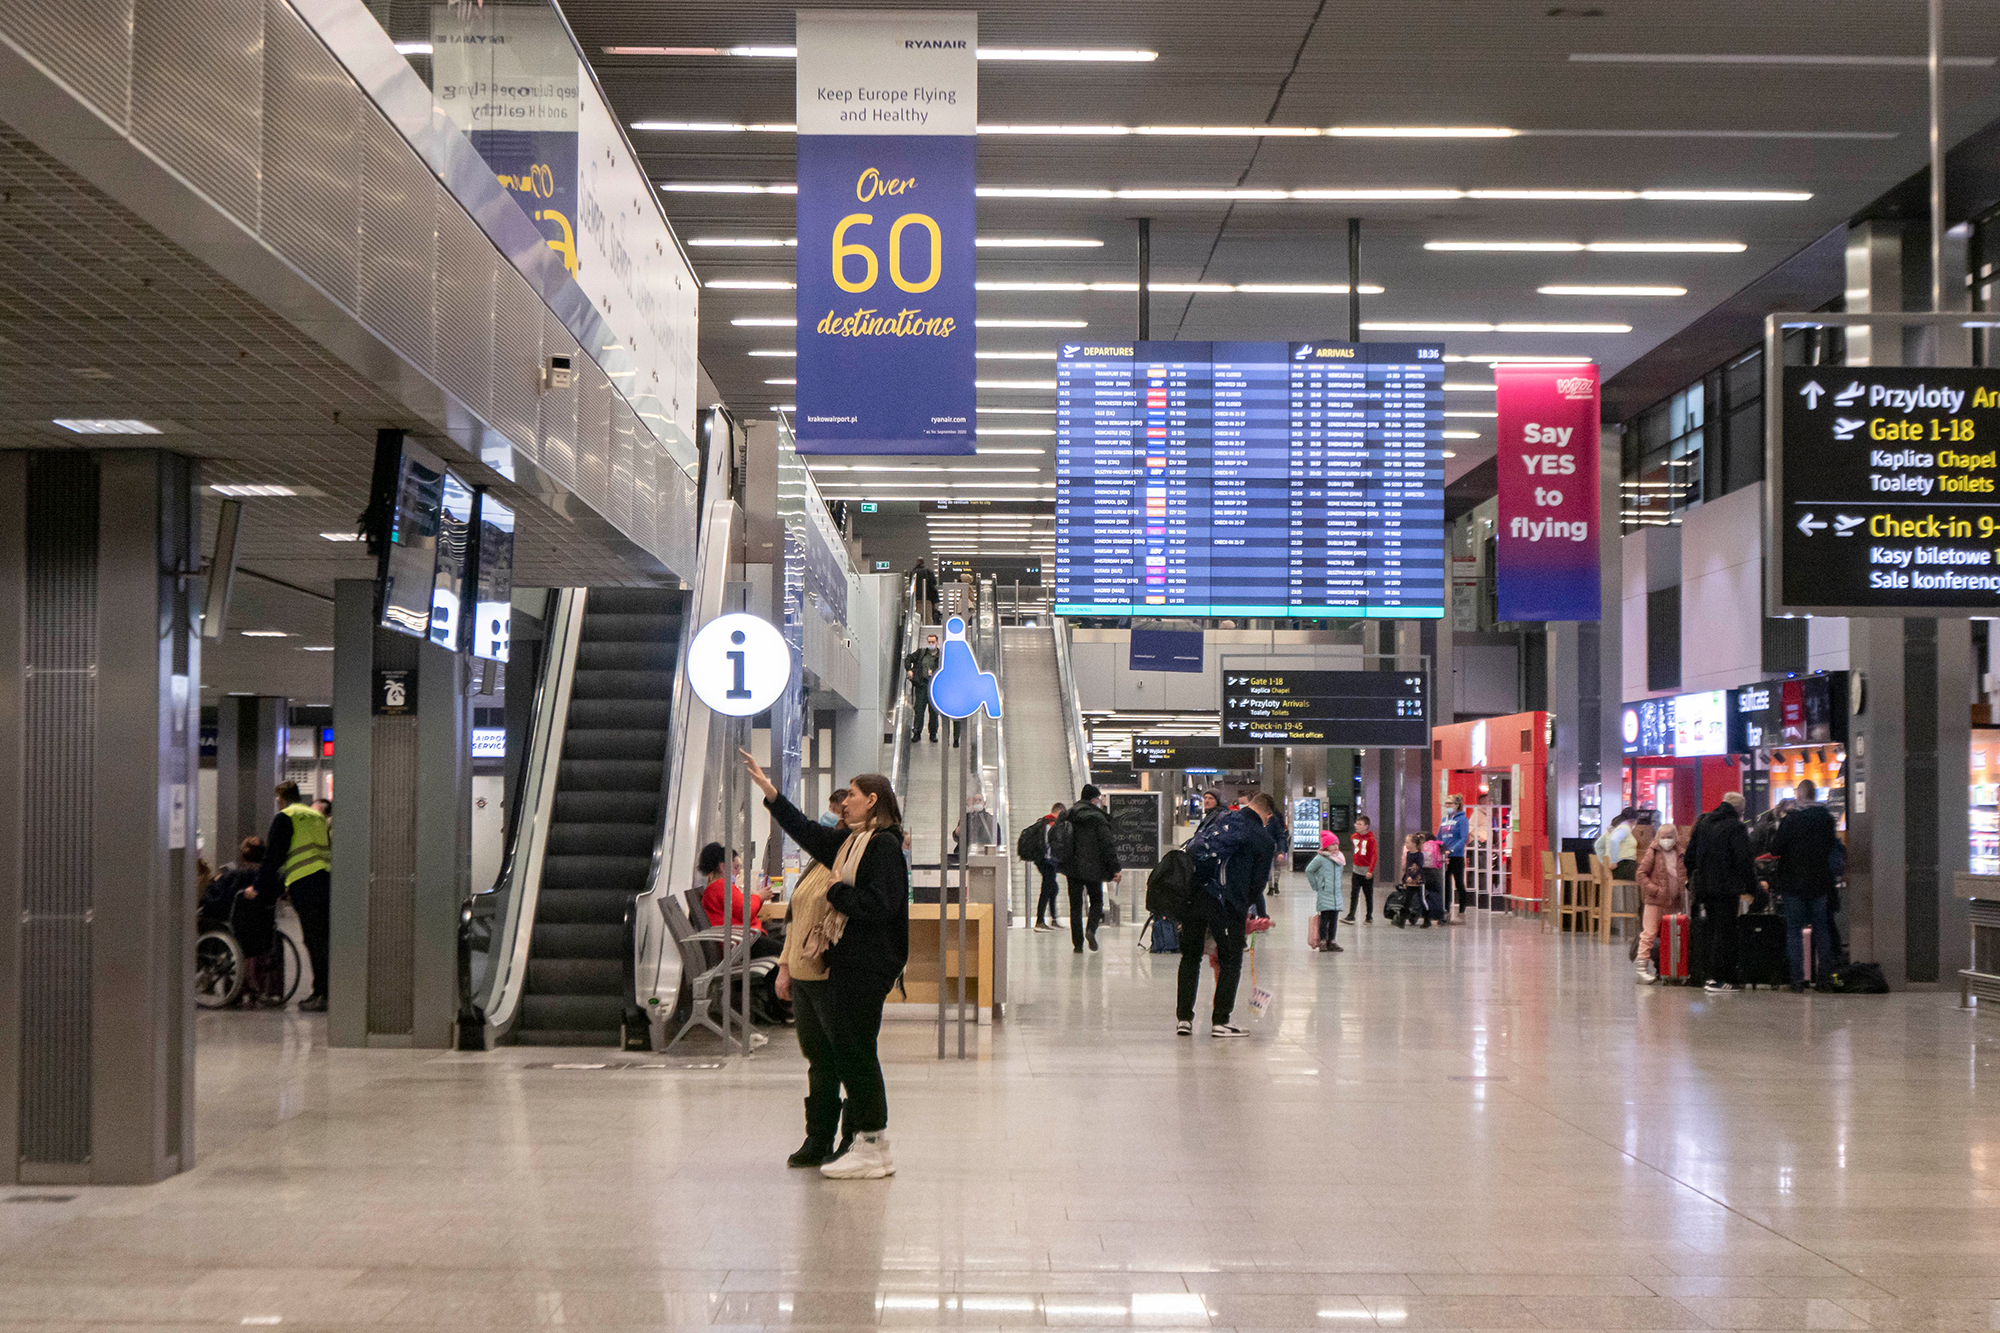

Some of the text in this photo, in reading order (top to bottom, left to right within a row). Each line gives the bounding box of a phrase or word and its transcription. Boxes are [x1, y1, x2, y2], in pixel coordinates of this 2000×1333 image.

[905, 40, 967, 49] RYANAIR
[817, 87, 957, 105] Keep Europe Flying
[840, 108, 929, 125] and Healthy
[856, 167, 918, 203] Over
[832, 213, 942, 294] 60
[817, 308, 956, 338] destinations
[1084, 347, 1134, 356] DEPARTURES
[1316, 349, 1355, 358] ARRIVALS
[1417, 349, 1440, 358] 18:36
[1869, 384, 1965, 414] Przyloty
[807, 416, 858, 424] krakowairport.pl
[931, 416, 967, 424] ryanair.com
[1523, 423, 1574, 447] Say
[1869, 418, 1976, 442] Gate 1-18
[1521, 454, 1576, 475] YES
[1870, 450, 1997, 472] Kaplica Chapel
[1870, 474, 1995, 496] Toalety Toilets
[1534, 487, 1564, 506] to
[1510, 516, 1588, 542] flying
[1869, 514, 1972, 538] Check-in
[1869, 547, 1912, 568] Kasy
[1915, 546, 1991, 566] biletowe
[1869, 571, 1909, 589] Sale
[1250, 678, 1284, 686] Gate 1-18
[1250, 699, 1310, 709] Przyloty Arrivals
[1250, 709, 1271, 717] Toalety
[1250, 722, 1303, 730] Check-in 19-45
[1747, 721, 1762, 747] bar
